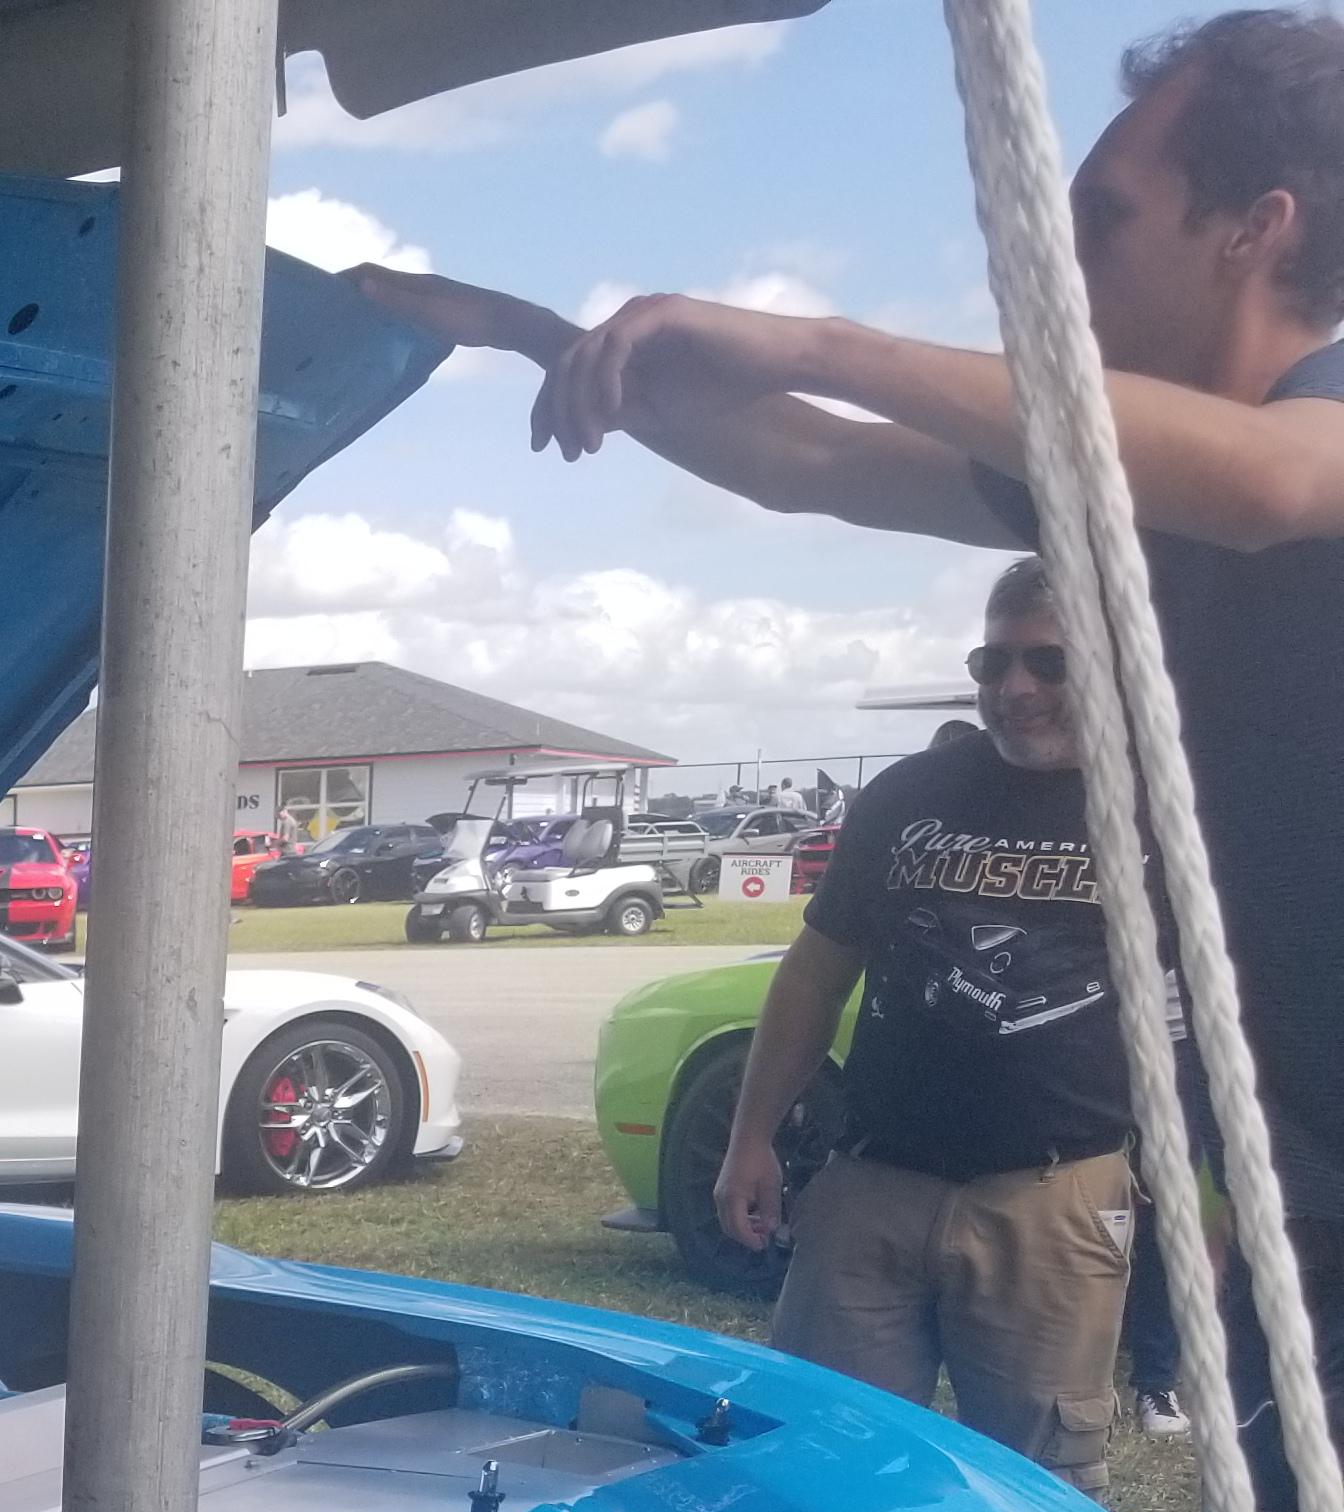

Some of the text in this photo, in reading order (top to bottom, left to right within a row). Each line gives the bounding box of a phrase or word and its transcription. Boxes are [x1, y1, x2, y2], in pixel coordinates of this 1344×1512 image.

[891, 819, 993, 853] Pure
[731, 859, 782, 868] AIRCRAFT
[740, 867, 770, 876] RIDES
[887, 850, 1102, 904] MUSCL
[947, 966, 1006, 1011] Plymouth
